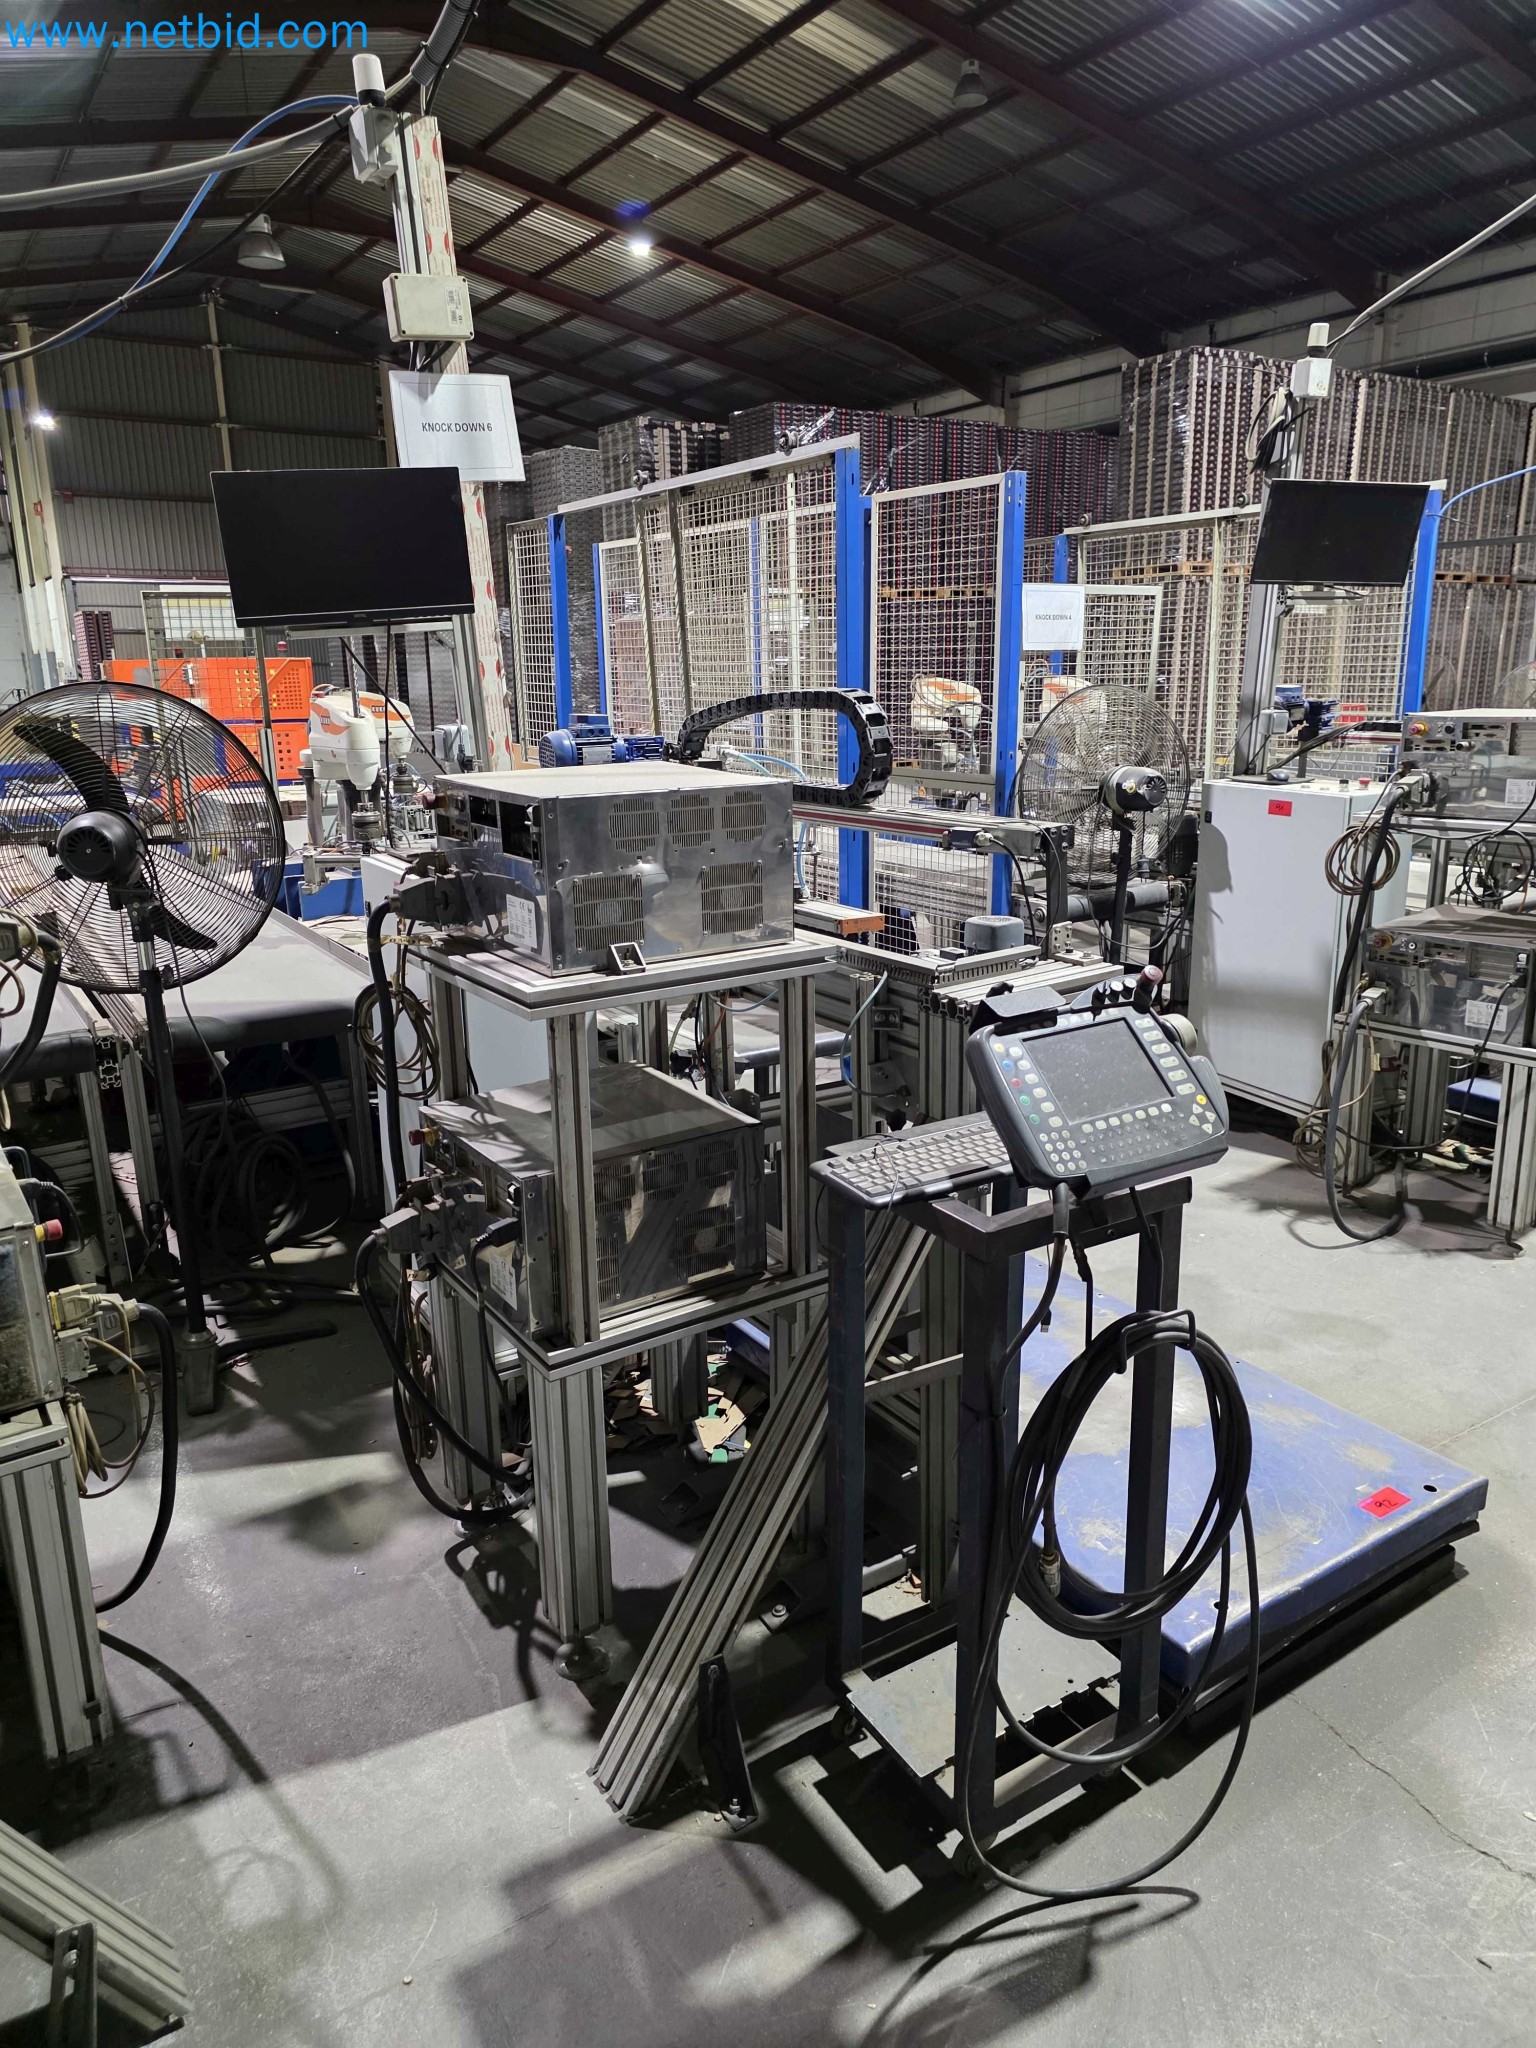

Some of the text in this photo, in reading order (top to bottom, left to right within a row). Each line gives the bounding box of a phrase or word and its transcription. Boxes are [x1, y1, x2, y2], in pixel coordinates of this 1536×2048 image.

[422, 422, 493, 432] KNOCK DOWN 6
[1374, 1499, 1399, 1509] 92
